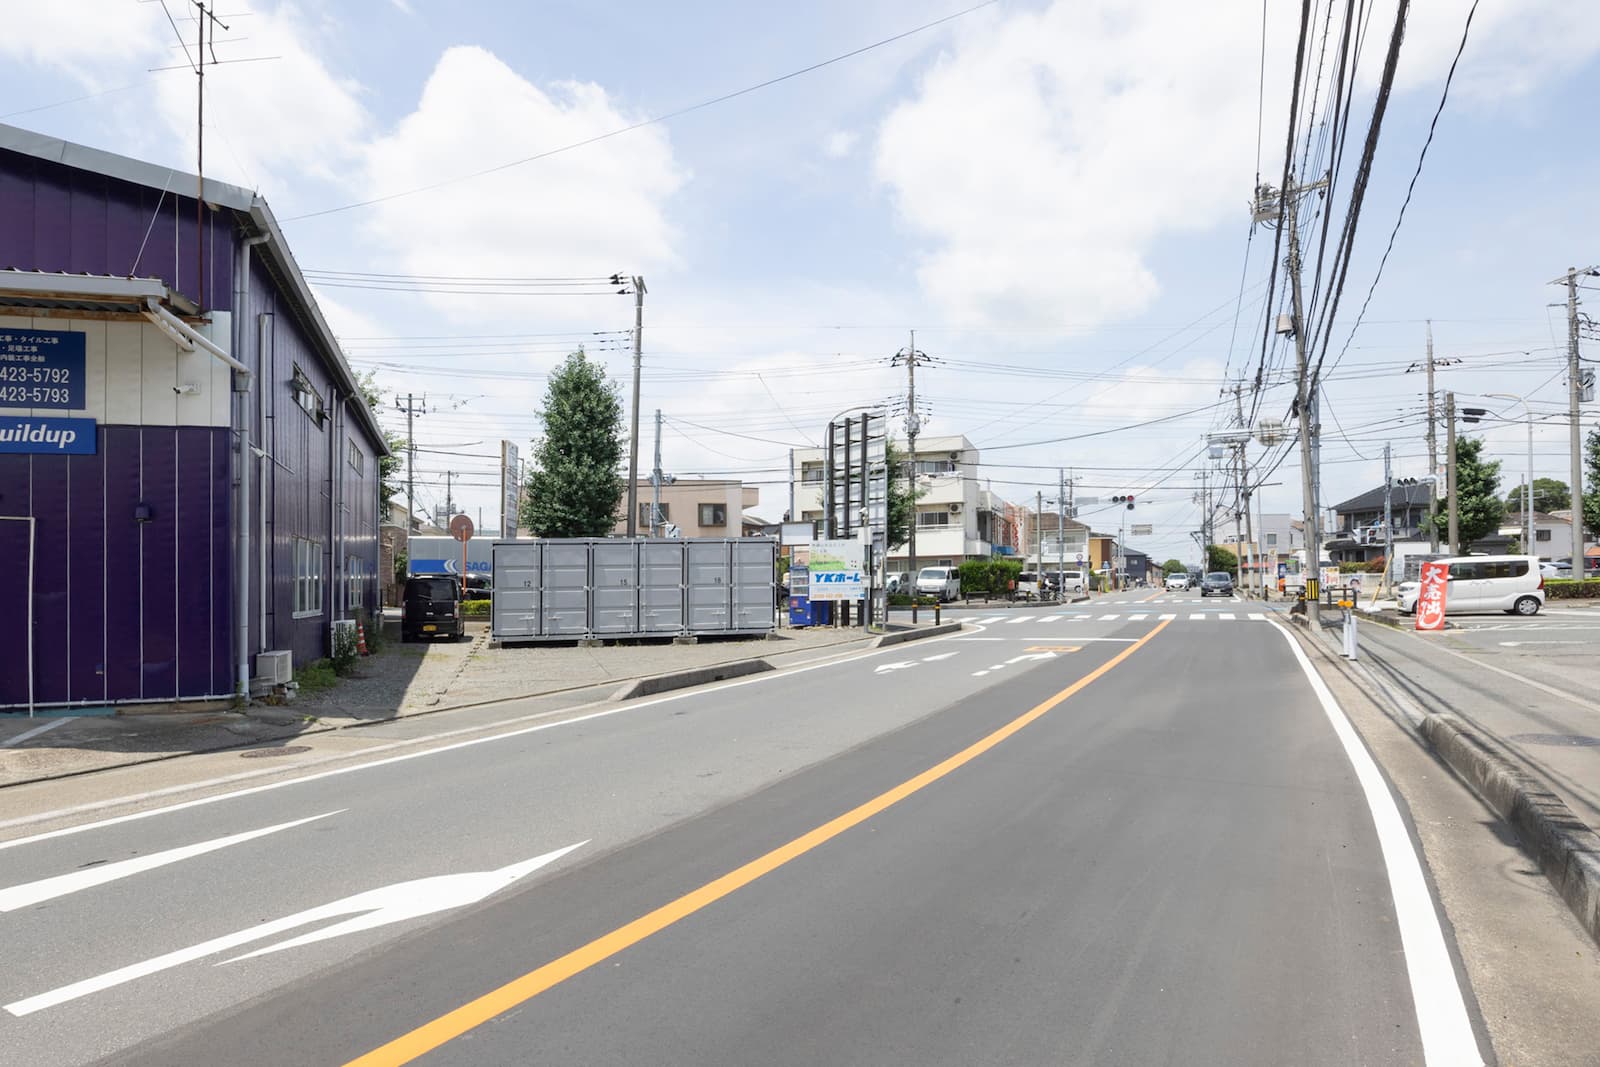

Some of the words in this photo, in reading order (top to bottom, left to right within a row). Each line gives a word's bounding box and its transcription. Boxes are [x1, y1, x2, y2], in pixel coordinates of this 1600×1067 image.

[0, 366, 69, 383] 423-5792
[0, 386, 70, 404] 423-5793
[465, 561, 491, 572] SAG
[1419, 566, 1446, 628] 大売出し
